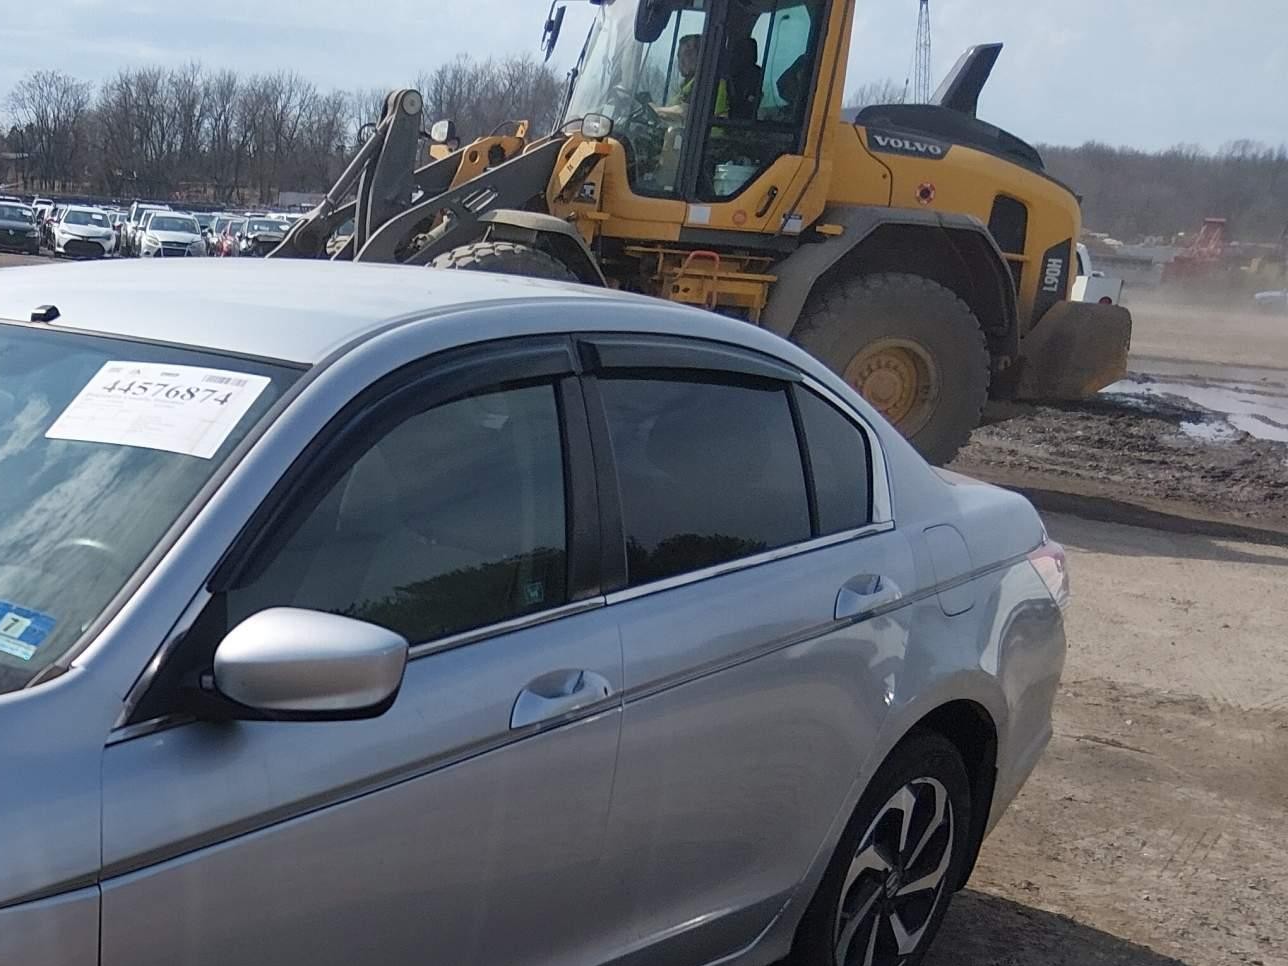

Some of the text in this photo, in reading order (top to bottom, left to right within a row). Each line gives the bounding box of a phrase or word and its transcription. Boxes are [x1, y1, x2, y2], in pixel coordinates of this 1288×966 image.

[873, 135, 942, 154] VOLVO
[1042, 258, 1063, 292] L90H
[103, 379, 233, 406] 44576874
[3, 616, 20, 633] 7
